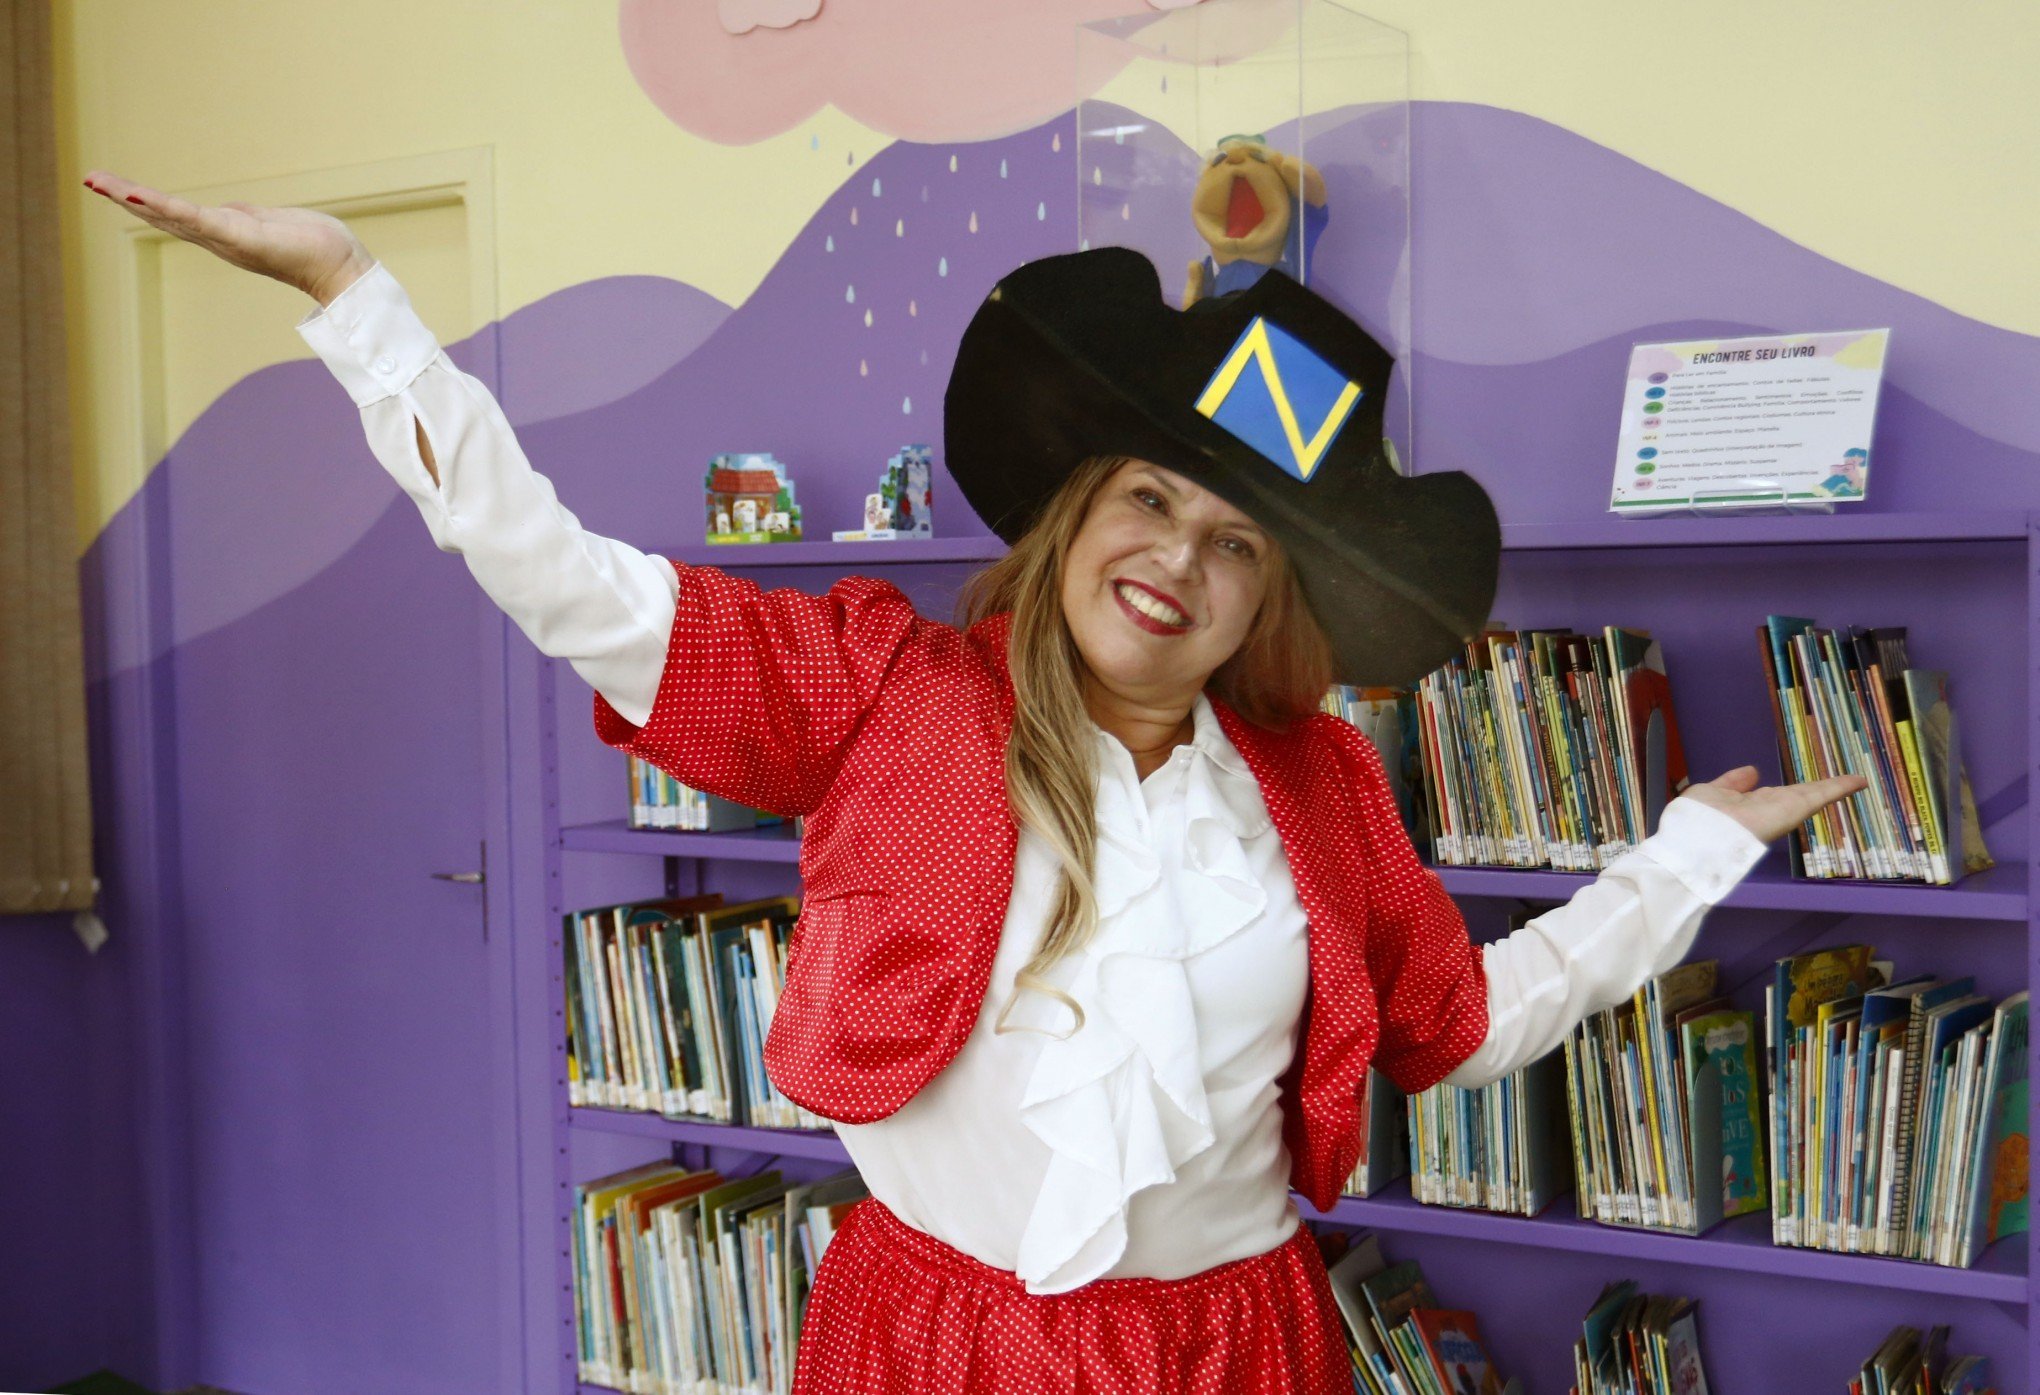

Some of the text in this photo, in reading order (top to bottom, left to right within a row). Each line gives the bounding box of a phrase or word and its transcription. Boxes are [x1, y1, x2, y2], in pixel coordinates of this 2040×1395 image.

[1195, 316, 1362, 480] N
[1693, 346, 1816, 364] ENCONTRE SEU LIVRO
